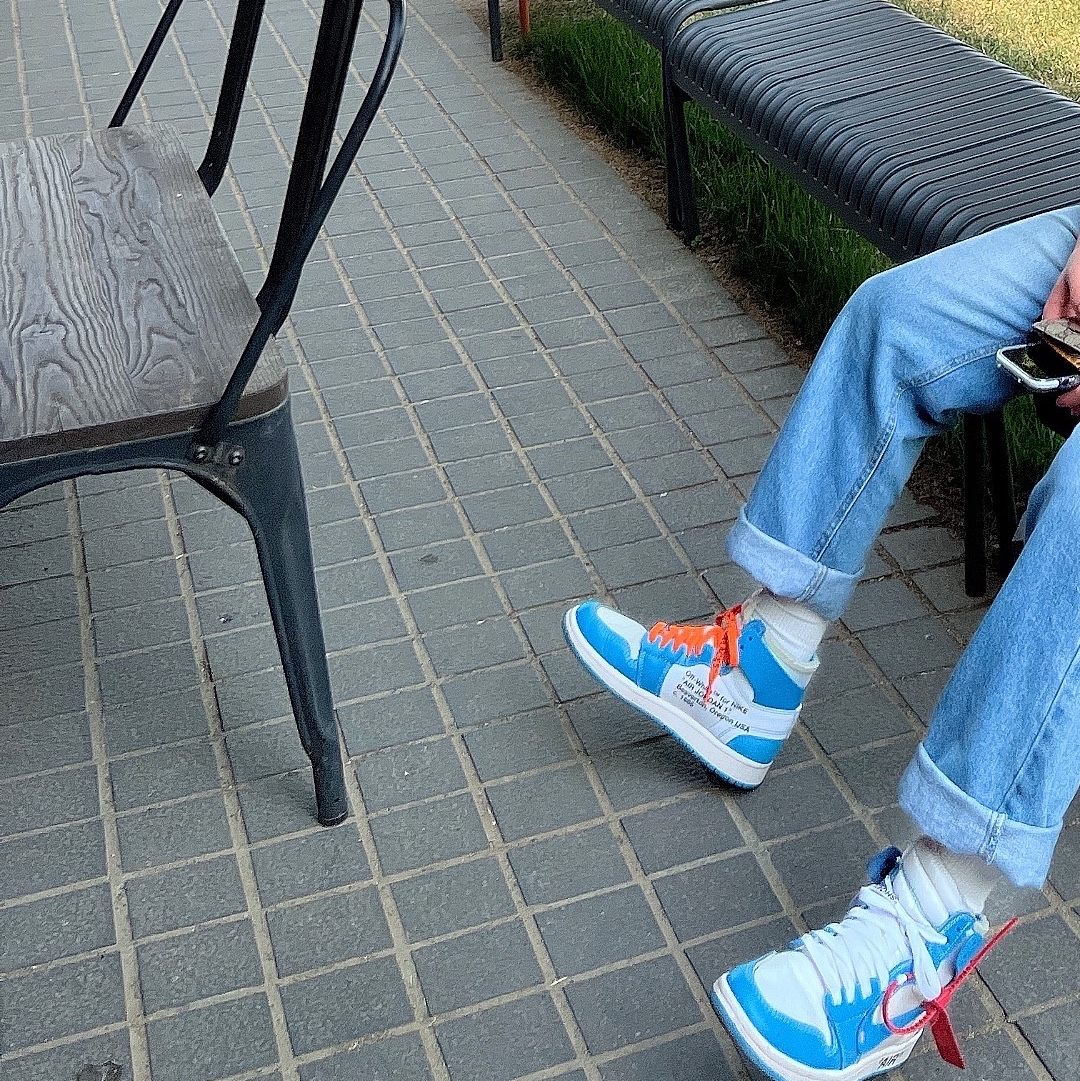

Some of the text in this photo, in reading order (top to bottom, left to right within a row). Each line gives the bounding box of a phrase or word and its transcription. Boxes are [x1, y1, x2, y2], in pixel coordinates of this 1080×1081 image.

[694, 689, 723, 710] JODAN
[730, 701, 749, 714] NIKE
[709, 707, 733, 724] Oregon
[734, 720, 750, 733] USA
